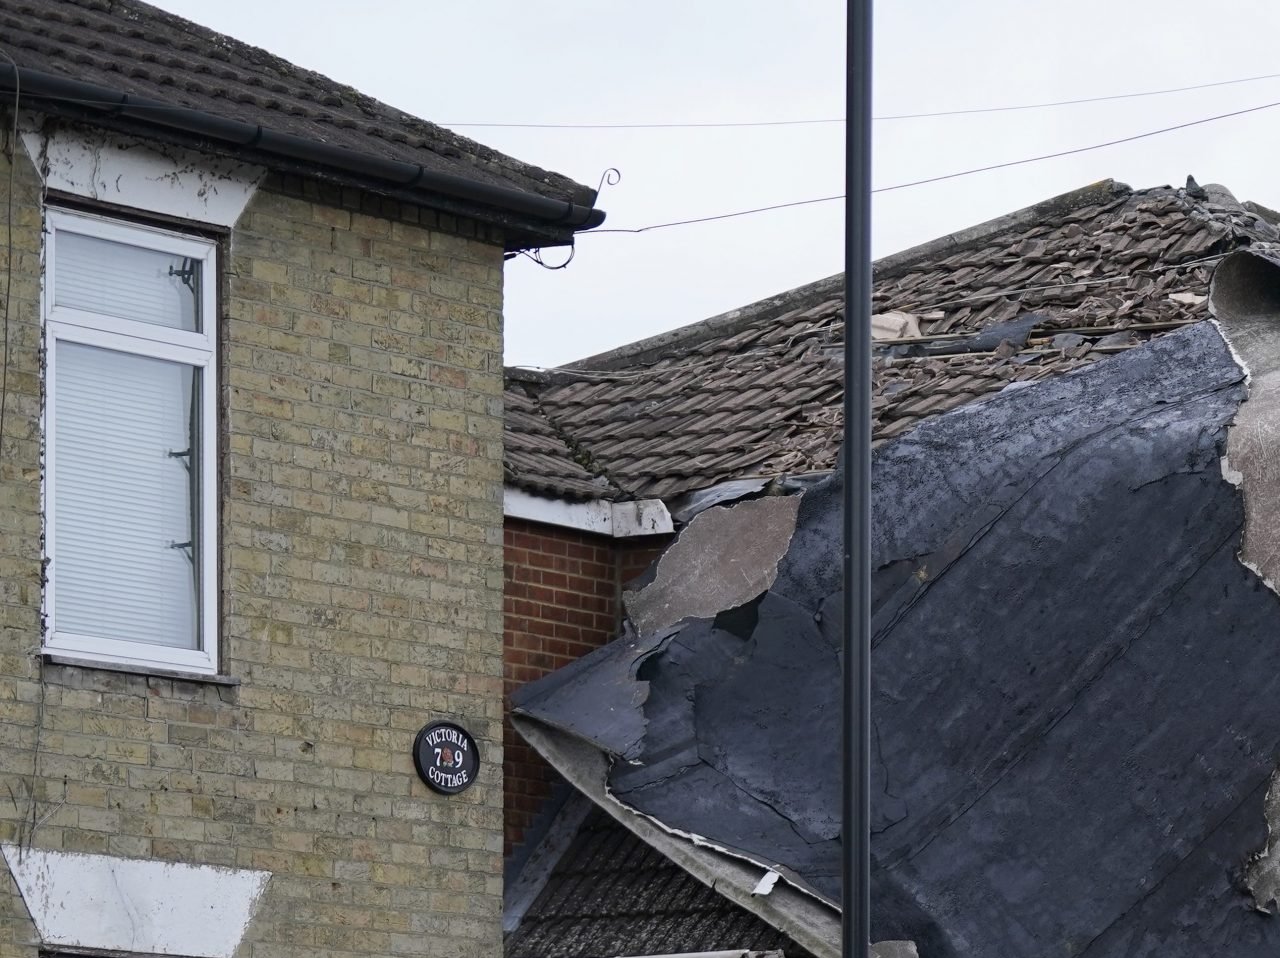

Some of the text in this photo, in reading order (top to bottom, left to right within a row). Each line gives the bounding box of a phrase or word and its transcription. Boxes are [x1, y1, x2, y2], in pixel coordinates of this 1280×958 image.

[426, 729, 468, 751] VICTORIA
[434, 748, 463, 768] 7 9
[429, 766, 468, 787] COTTAGE
